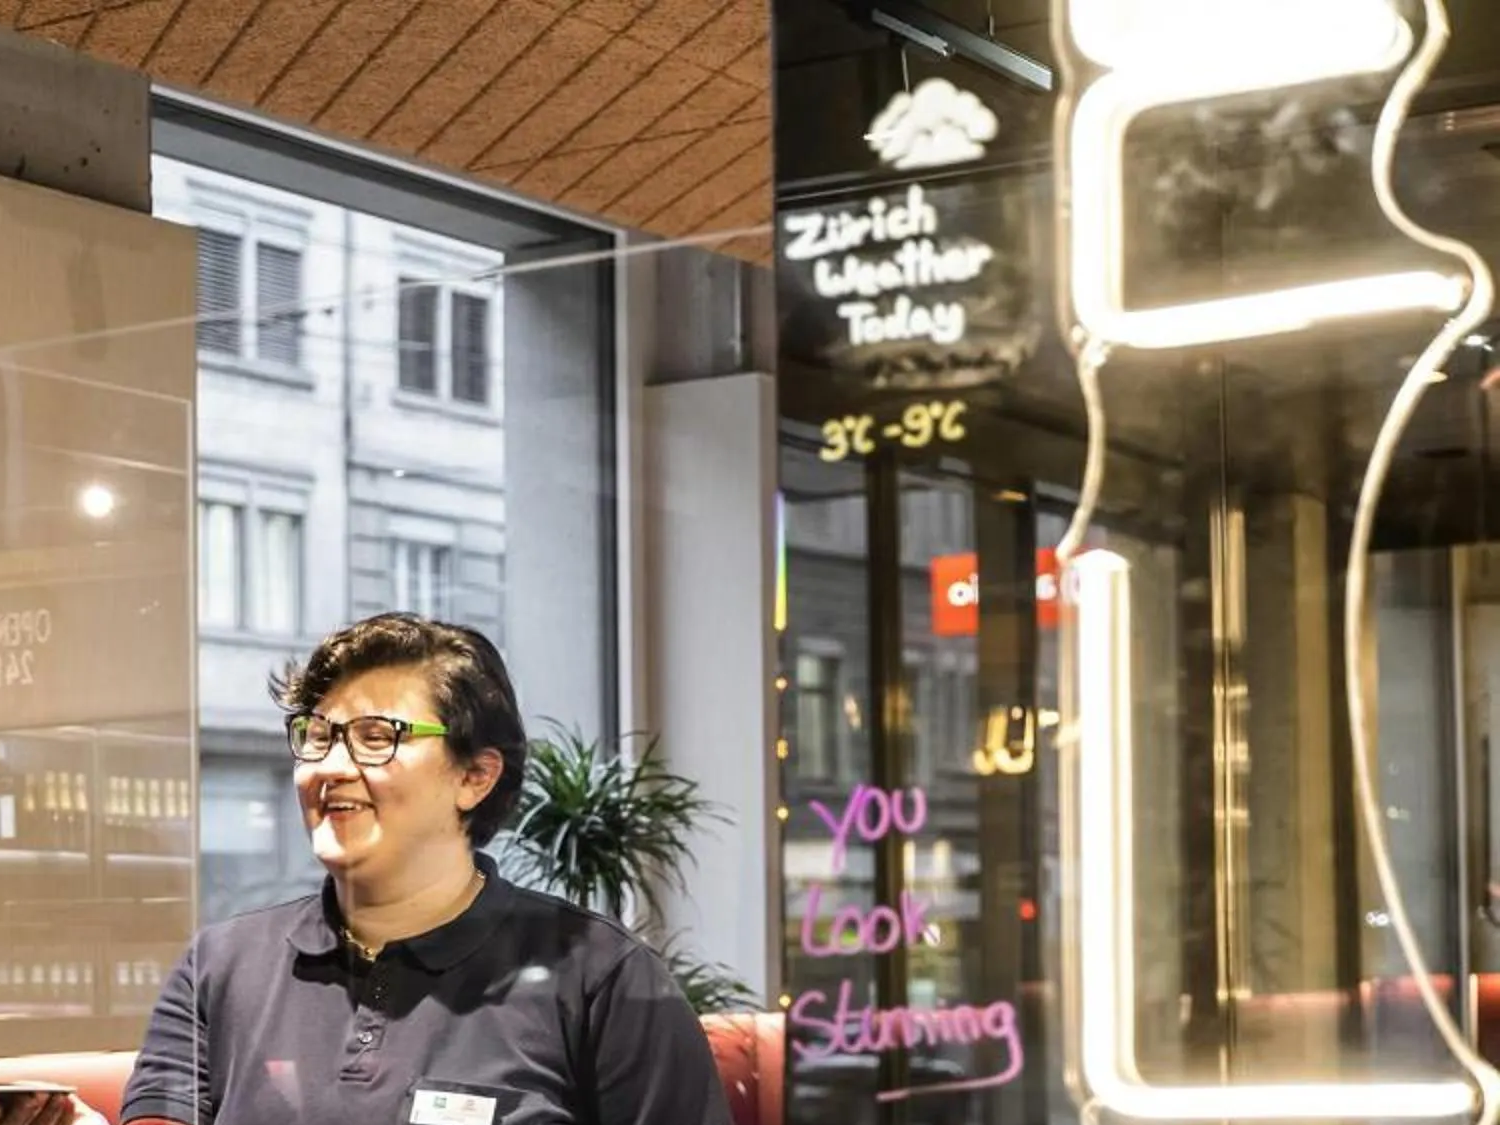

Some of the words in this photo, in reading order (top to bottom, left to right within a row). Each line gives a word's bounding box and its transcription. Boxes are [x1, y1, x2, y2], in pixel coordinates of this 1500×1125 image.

[784, 184, 937, 260] Zürich
[813, 237, 994, 297] Weather
[835, 295, 966, 344] Today
